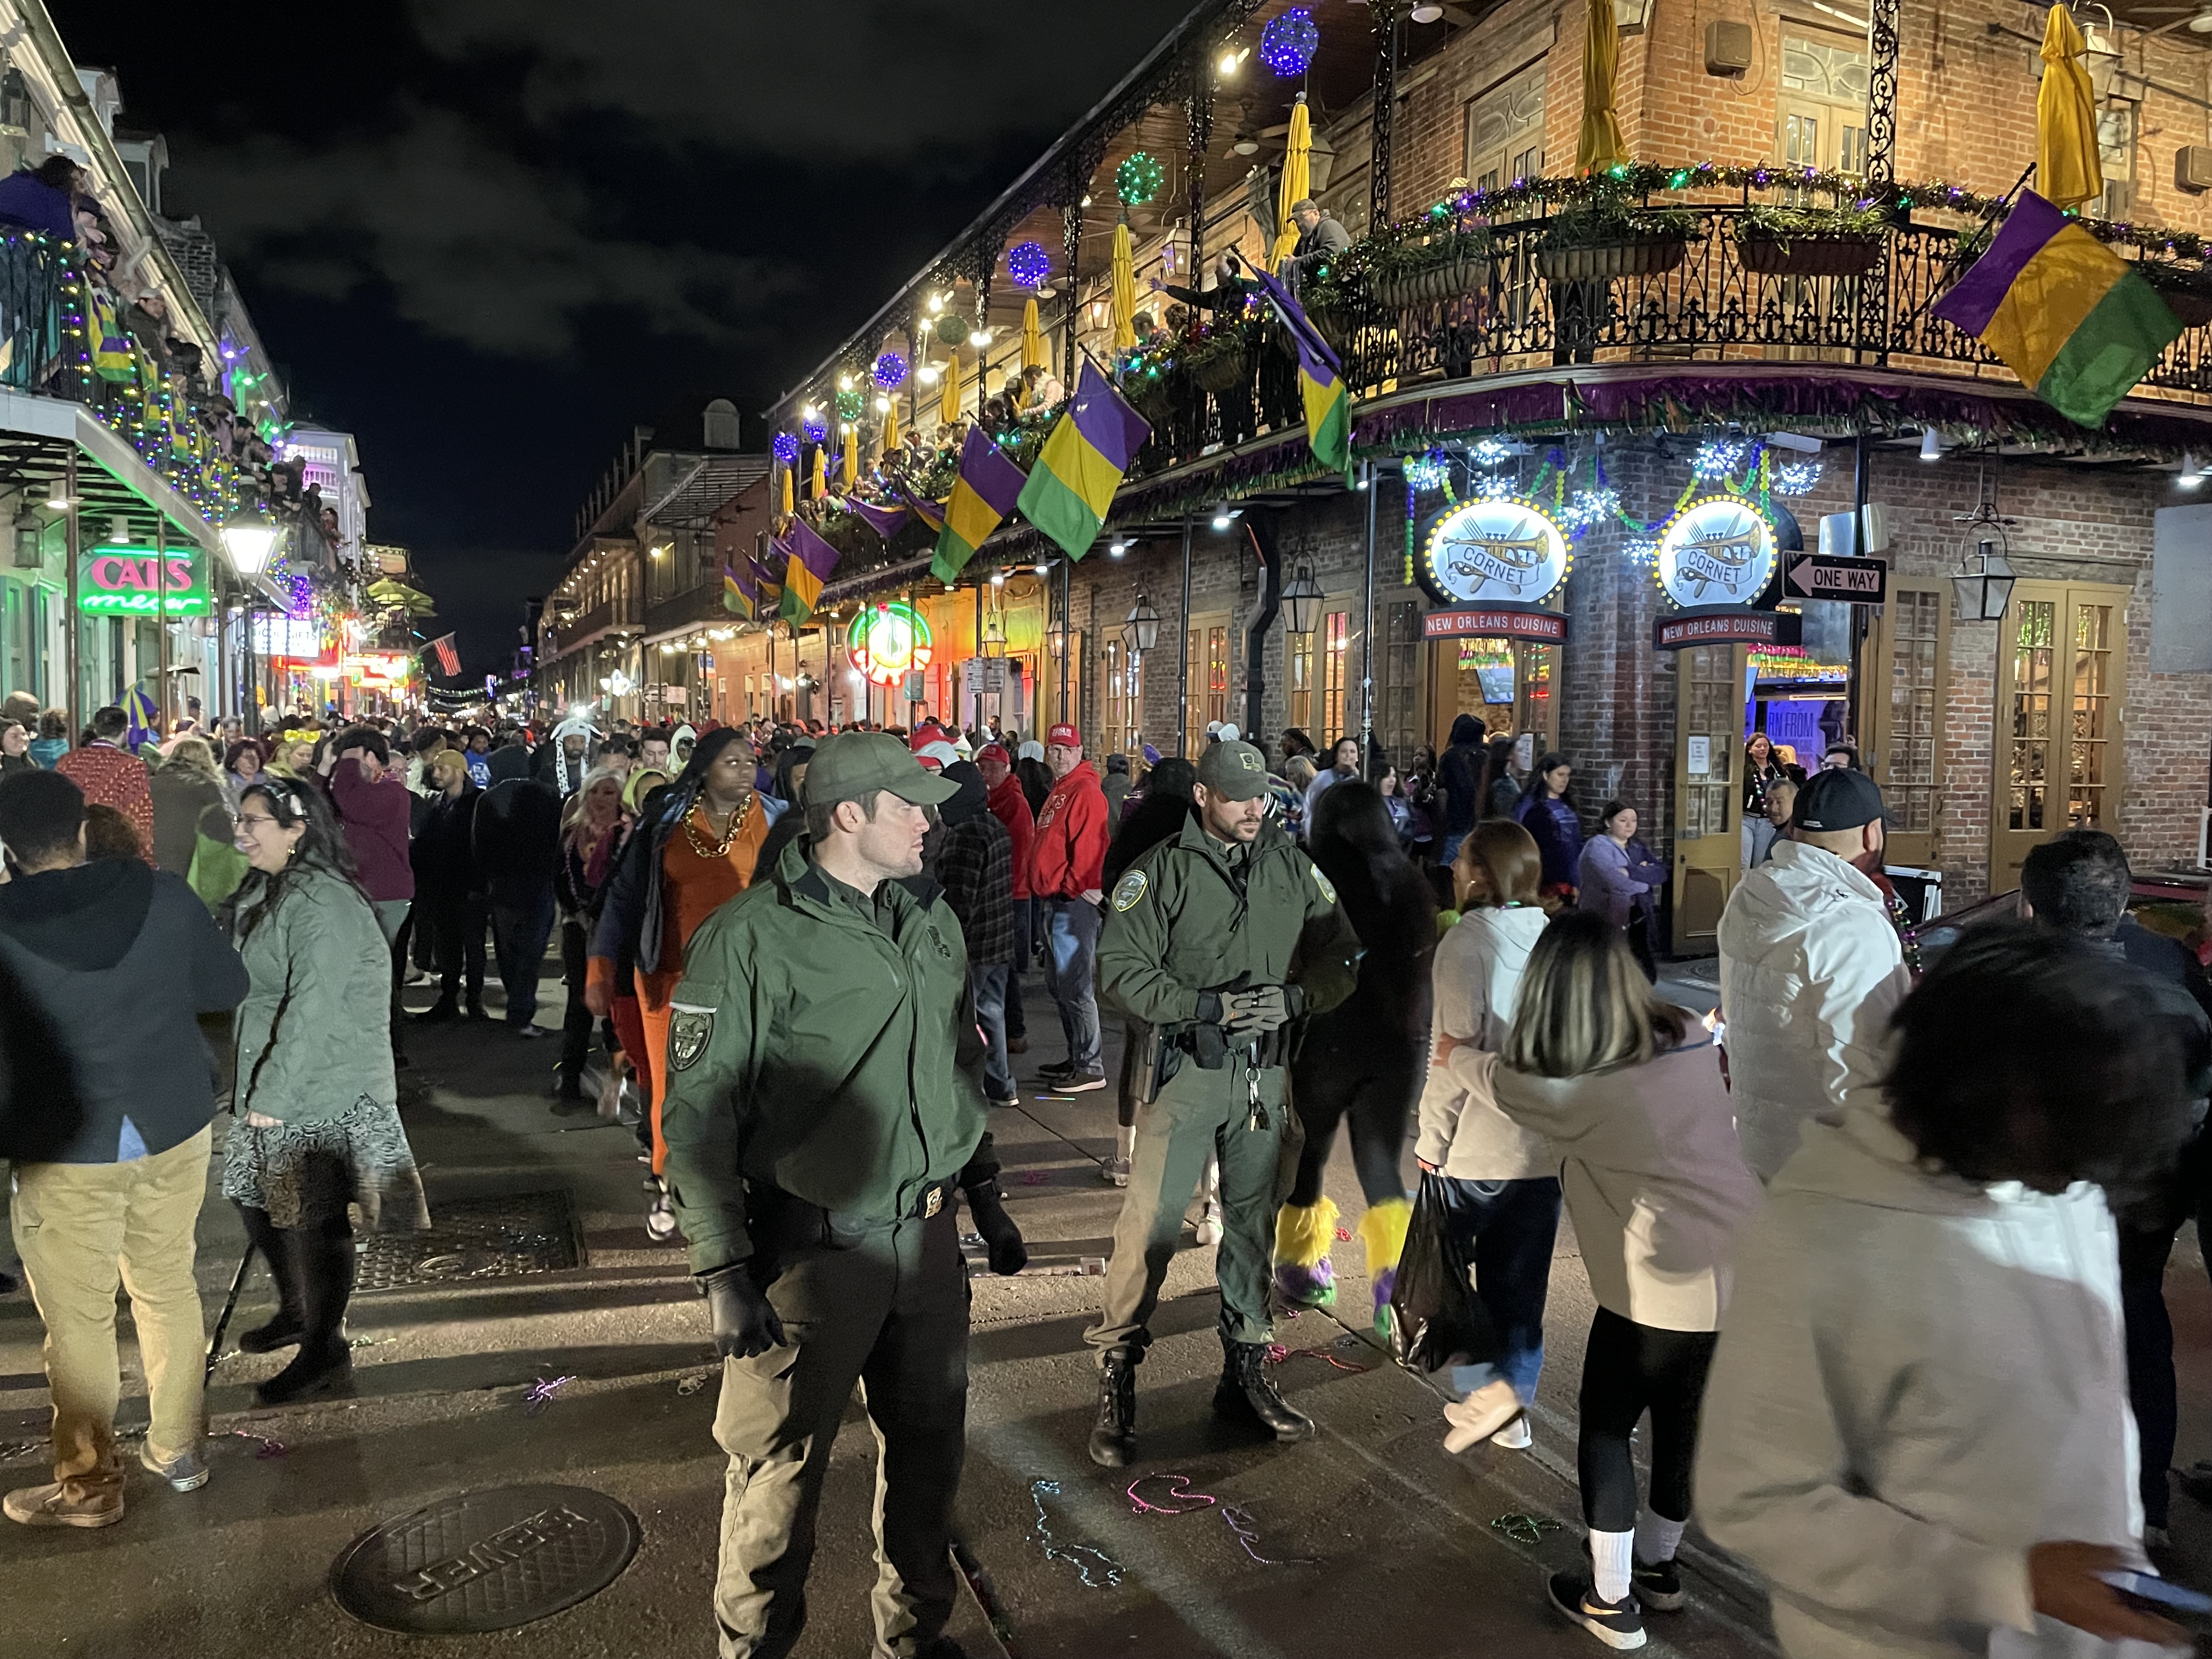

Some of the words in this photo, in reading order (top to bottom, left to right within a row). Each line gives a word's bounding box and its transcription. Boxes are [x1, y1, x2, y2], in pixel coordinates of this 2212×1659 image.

[92, 557, 192, 591] CATS
[1464, 546, 1527, 584] CORNET
[1688, 550, 1741, 583] CORNET
[1814, 568, 1842, 587] ONE
[1848, 571, 1876, 590] WAY
[1427, 617, 1452, 632] NEW
[1457, 616, 1508, 629] ORLEANS
[1513, 616, 1559, 634] CUISINE
[1662, 625, 1684, 640] NEW
[1687, 620, 1729, 635] ORLEANS
[1734, 618, 1774, 635] CUISINE
[1784, 712, 1814, 737] FROM
